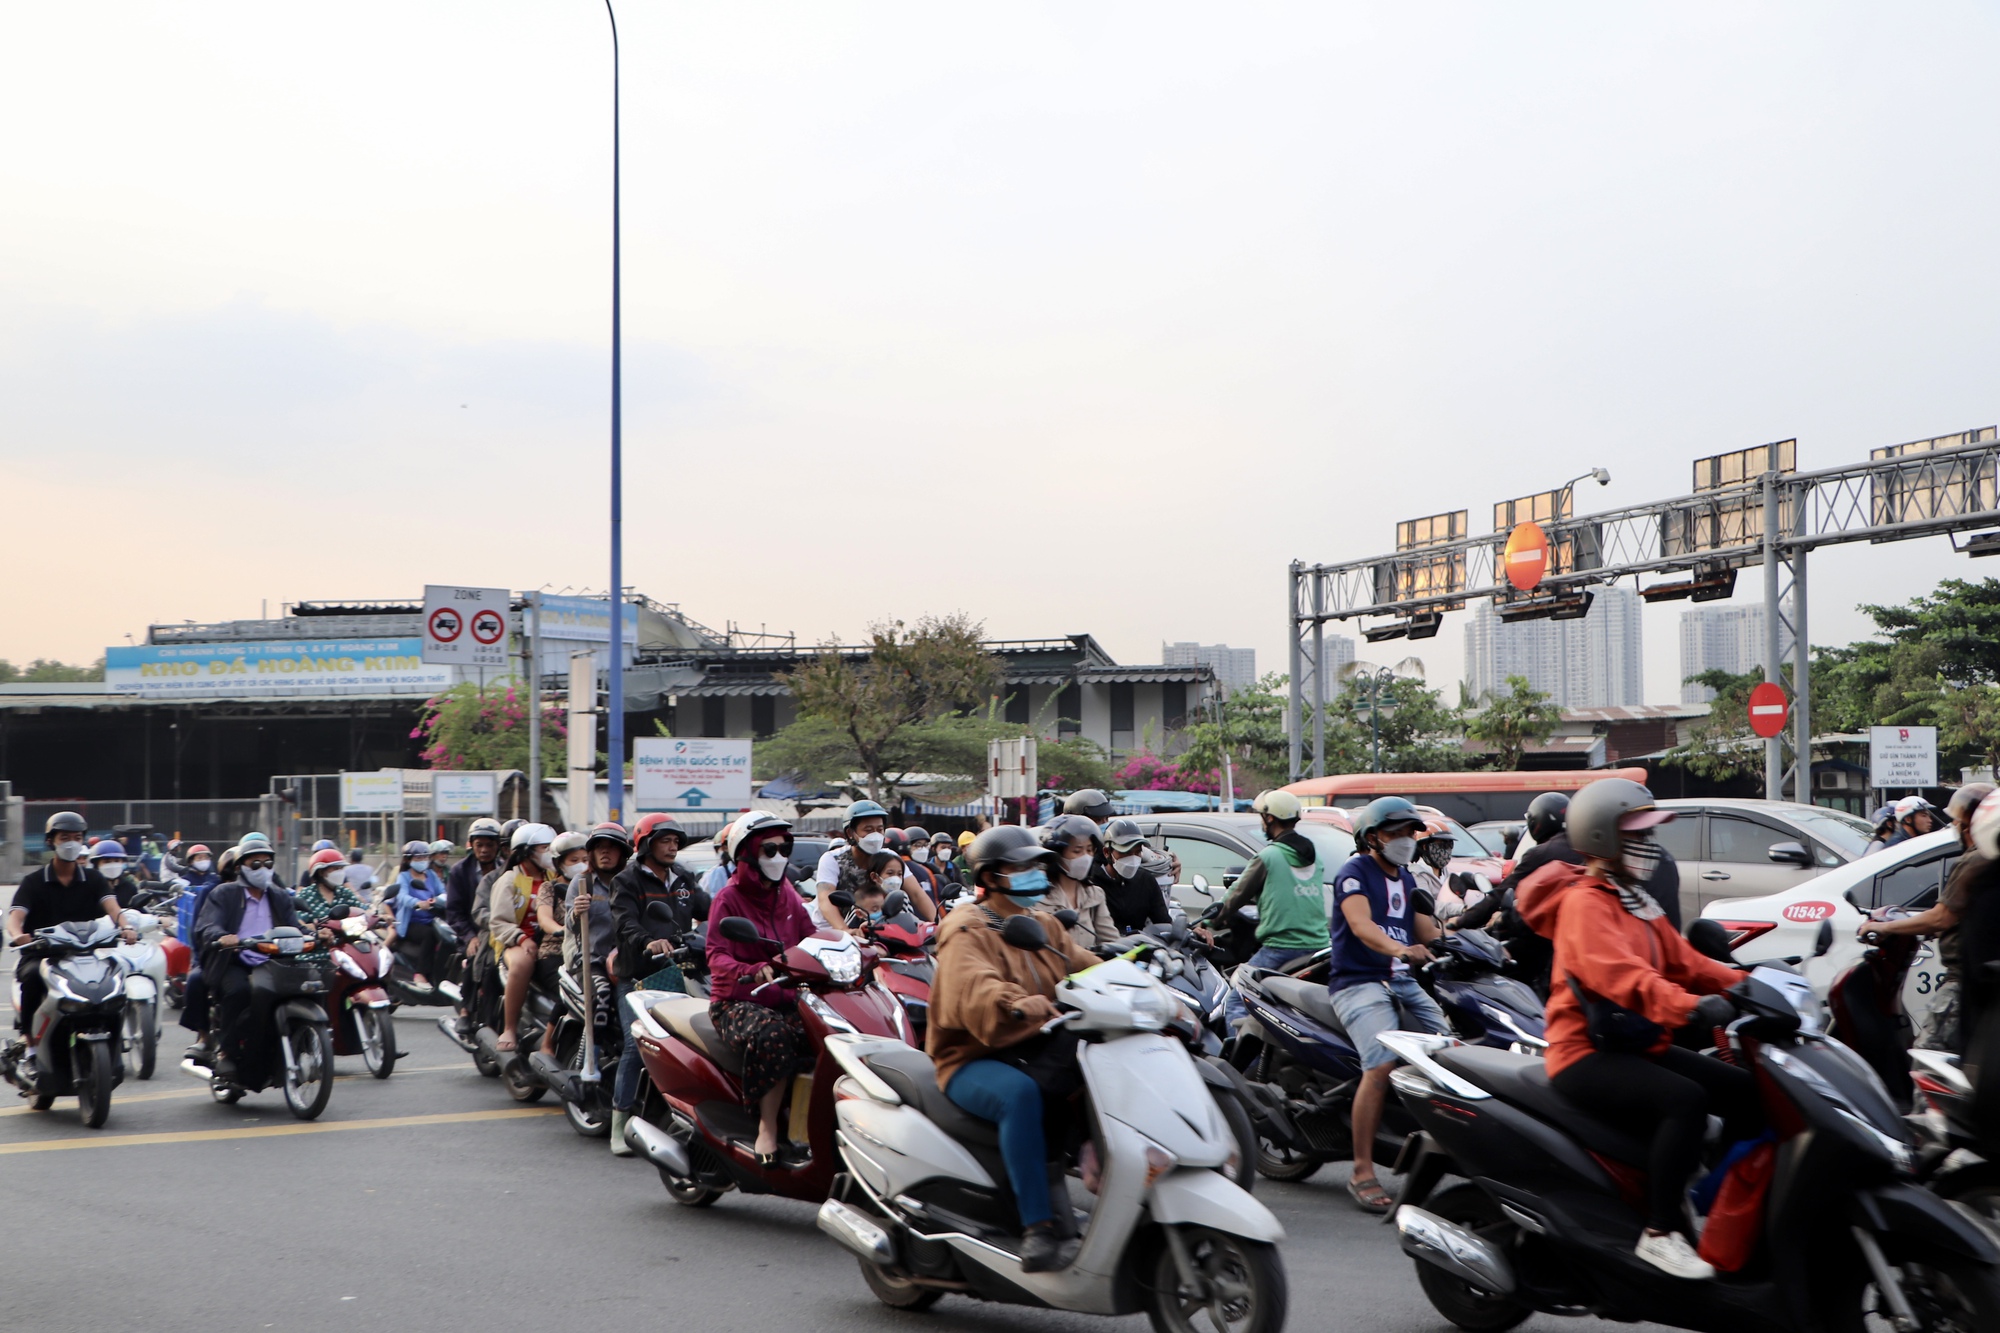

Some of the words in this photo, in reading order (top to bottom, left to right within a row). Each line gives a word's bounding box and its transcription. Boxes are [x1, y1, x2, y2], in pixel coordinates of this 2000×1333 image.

[454, 589, 482, 600] ZONE
[377, 642, 399, 651] KIM
[141, 661, 199, 677] KHO
[209, 656, 247, 675] ĐÁ
[258, 655, 355, 674] HOÀNG
[365, 655, 418, 671] KIM
[639, 754, 663, 767] BỆNH
[666, 755, 687, 767] VIỆN
[689, 754, 718, 766] QUỐC
[721, 754, 733, 766] TẾ
[733, 756, 747, 766] MỸ
[1294, 882, 1319, 897] Grab
[1787, 906, 1826, 919] 11542
[591, 974, 611, 1026] DKNY
